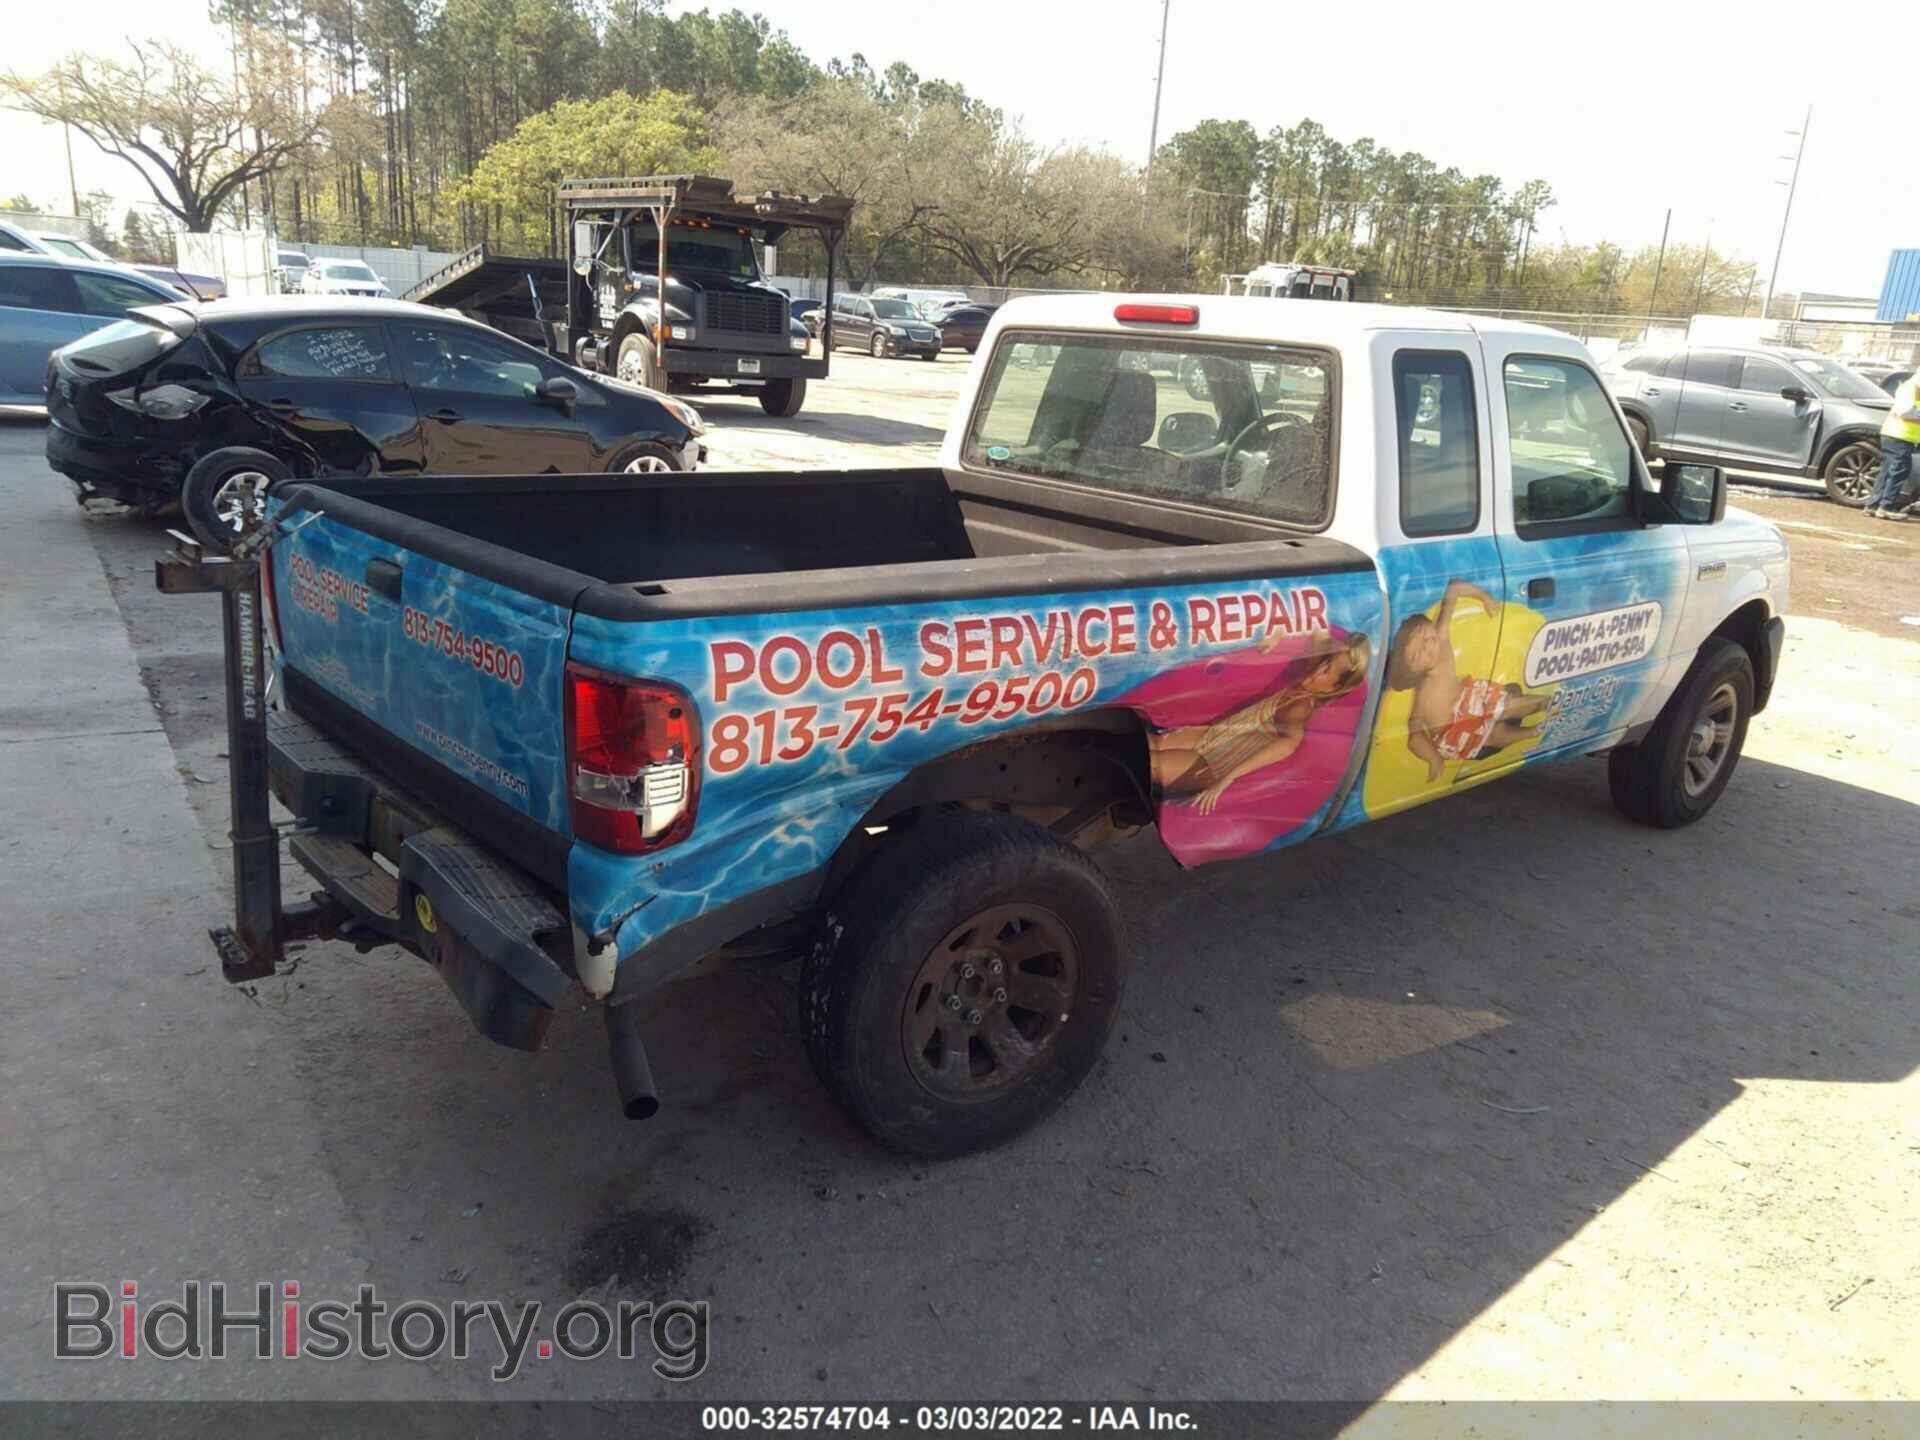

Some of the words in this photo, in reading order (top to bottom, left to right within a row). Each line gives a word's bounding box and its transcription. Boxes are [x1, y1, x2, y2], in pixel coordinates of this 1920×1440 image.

[290, 553, 319, 587] POOL
[320, 567, 370, 614] SERVICE
[403, 606, 523, 687] 813-754-9500
[709, 628, 904, 703] POOL
[919, 604, 1138, 678] SERVICE
[1150, 601, 1178, 651] &
[1187, 588, 1330, 645] REPAIR
[708, 667, 1097, 773] 813-754-9500
